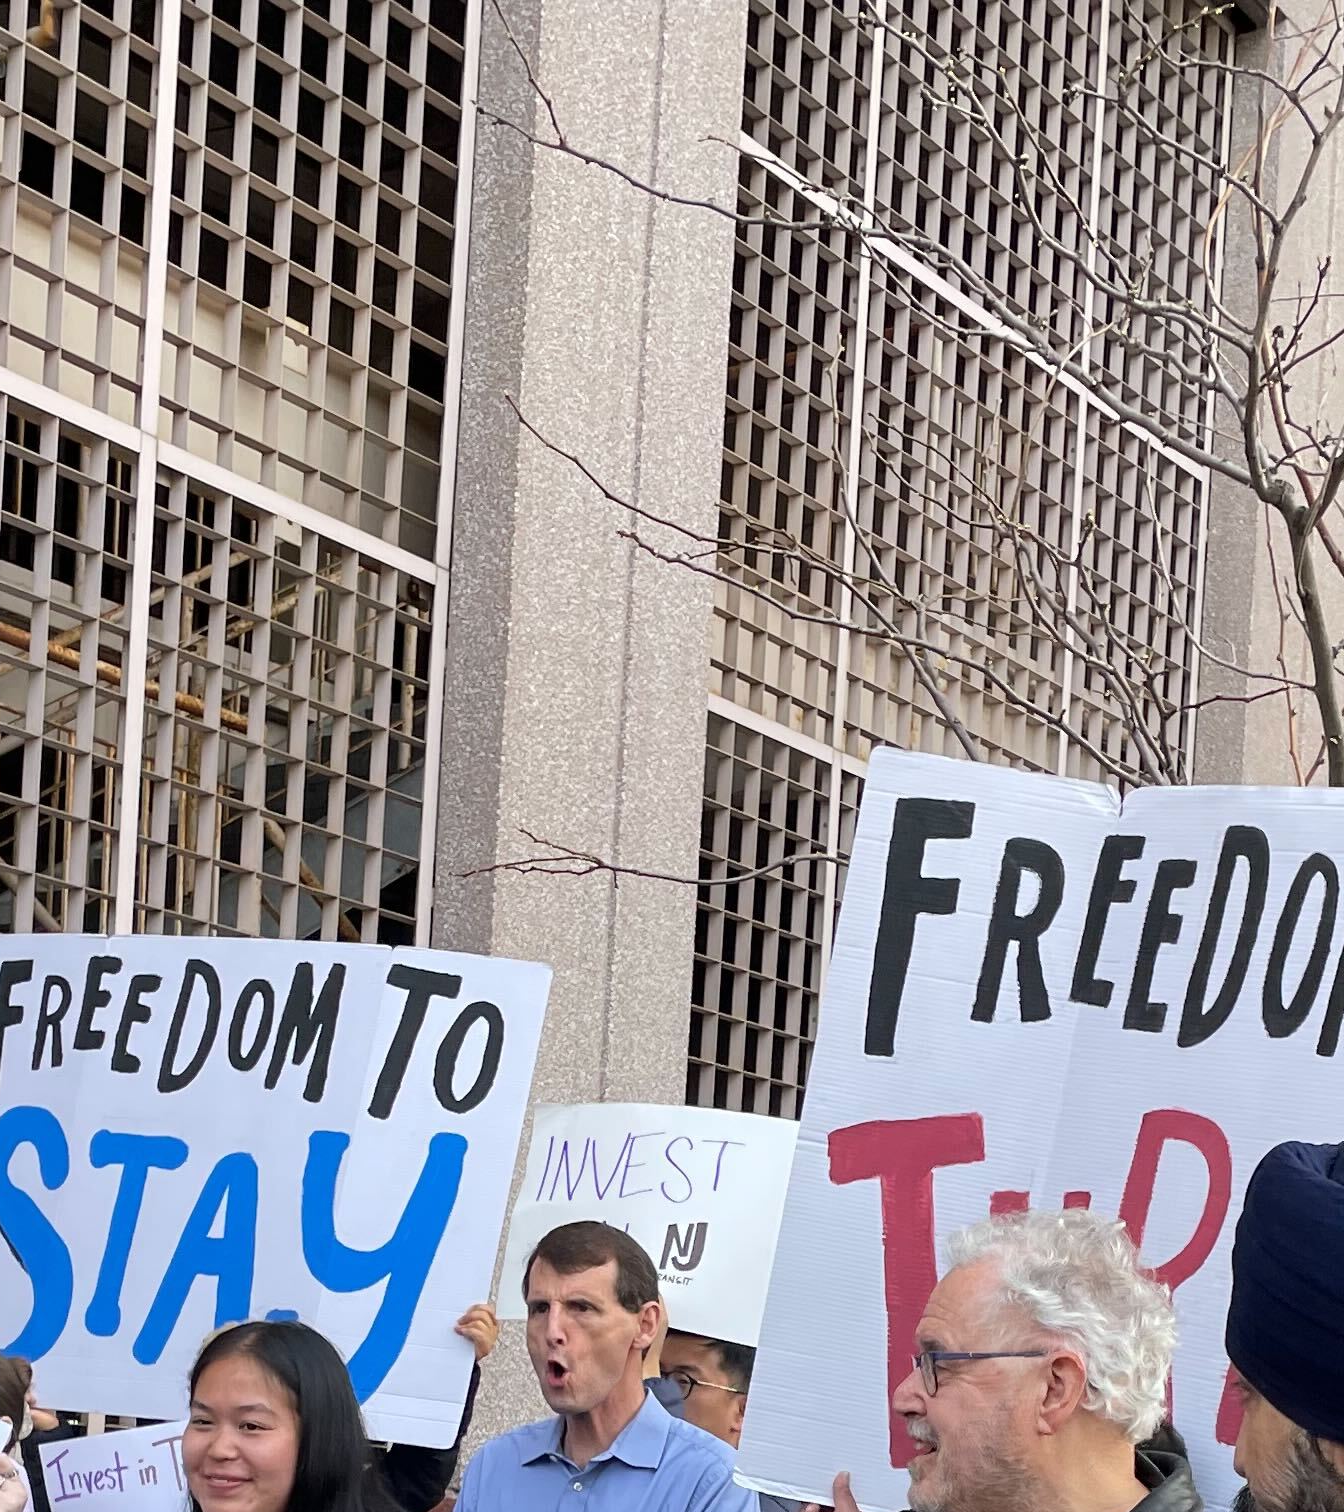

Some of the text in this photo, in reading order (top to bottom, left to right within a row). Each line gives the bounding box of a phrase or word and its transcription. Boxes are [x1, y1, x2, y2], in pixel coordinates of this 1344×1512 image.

[368, 963, 505, 1120] TO
[537, 1132, 746, 1203] INVEST
[659, 1222, 708, 1271] NJ
[46, 1449, 128, 1502] Invest
[138, 1458, 158, 1485] in
